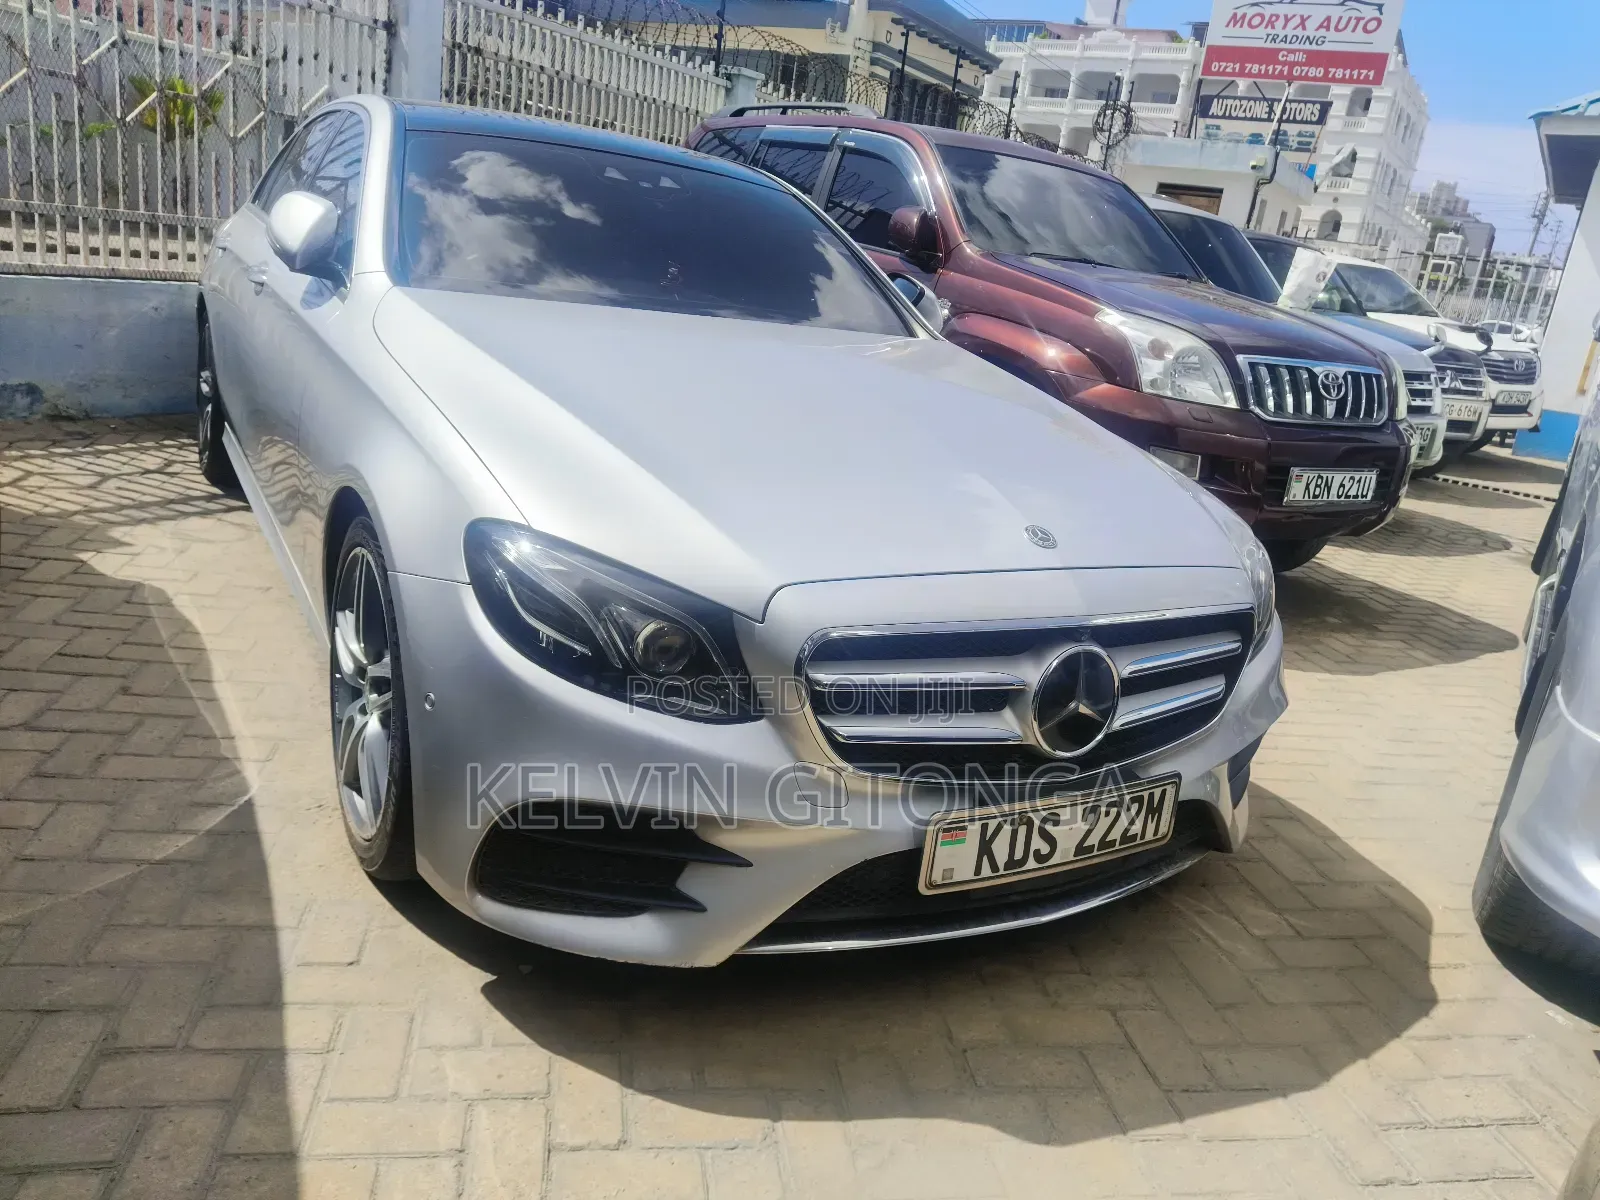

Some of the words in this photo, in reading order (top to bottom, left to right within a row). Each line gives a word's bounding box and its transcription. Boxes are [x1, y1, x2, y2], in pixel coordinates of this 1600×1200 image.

[1225, 11, 1312, 31] MORYX
[1315, 15, 1383, 35] AUTO
[1263, 33, 1327, 47] TRADING
[1278, 51, 1307, 62] Call:
[1211, 61, 1240, 73] 0721
[1244, 63, 1288, 76] 781171
[1293, 67, 1324, 78] 0780
[1328, 68, 1375, 80] 781171
[1209, 98, 1269, 119] AUTOZONE
[1302, 473, 1334, 500] KBN
[1337, 475, 1373, 500] 621U
[973, 811, 1062, 877] KDS
[1072, 788, 1168, 858] 222M
